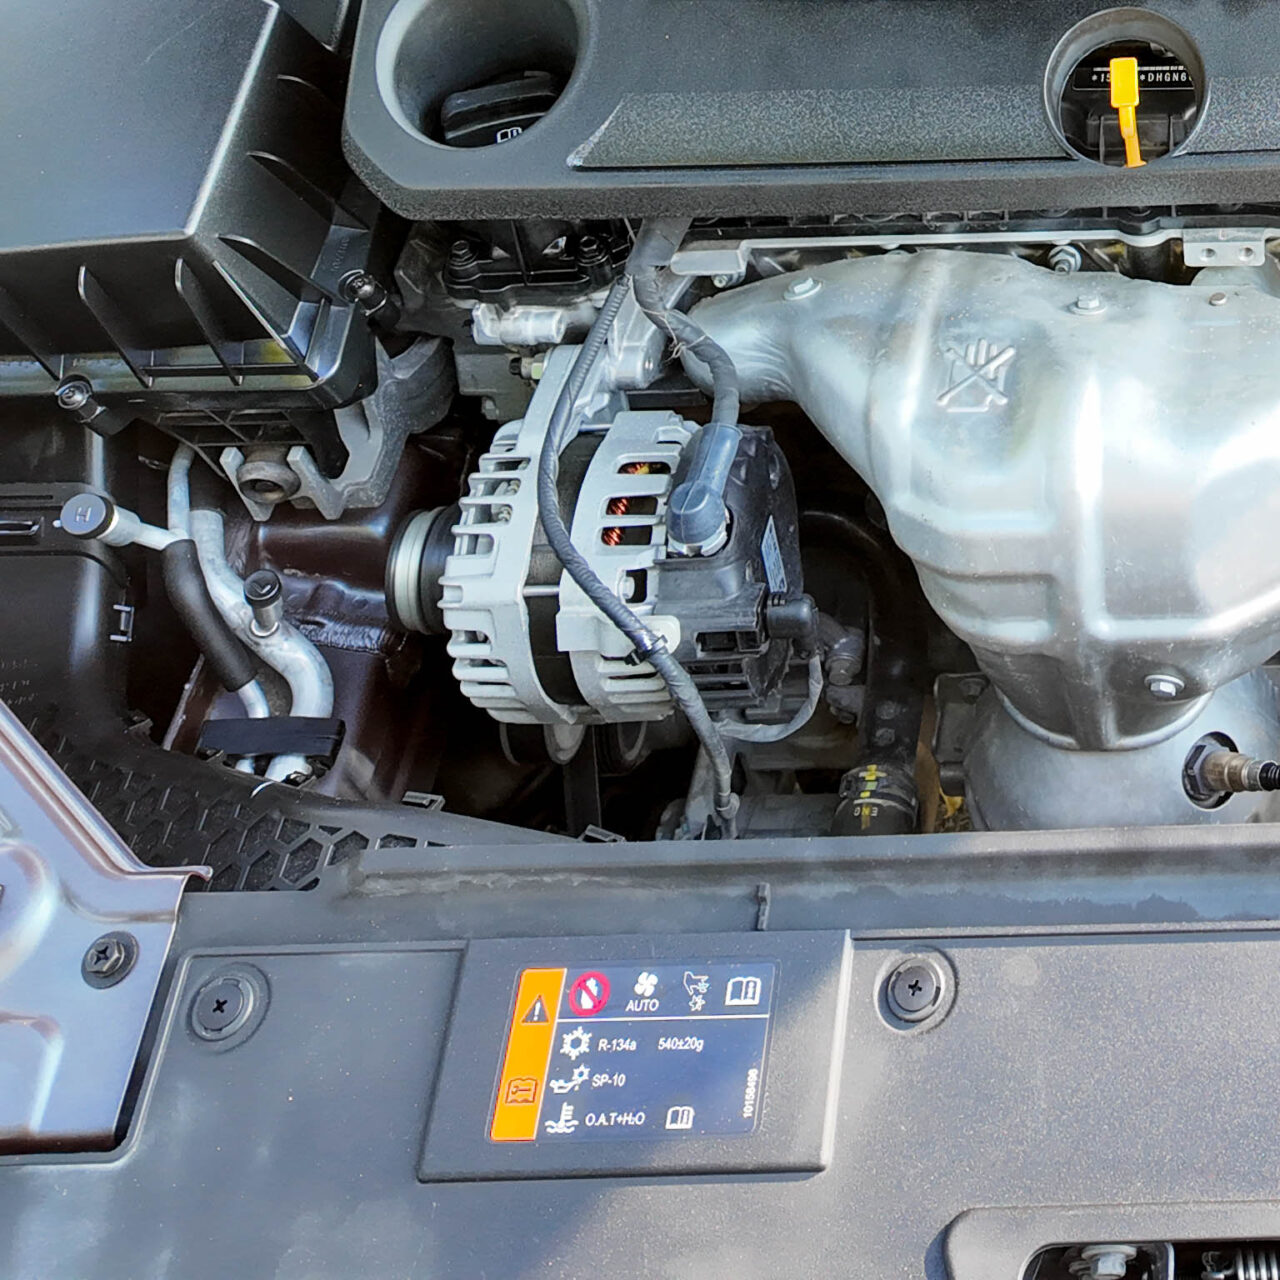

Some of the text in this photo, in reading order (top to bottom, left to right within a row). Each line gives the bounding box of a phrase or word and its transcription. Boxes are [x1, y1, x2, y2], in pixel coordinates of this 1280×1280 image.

[75, 506, 92, 523] H
[625, 999, 660, 1012] AUTO
[598, 1036, 704, 1053] R-134a 540±20g
[591, 1073, 626, 1088] SP-10
